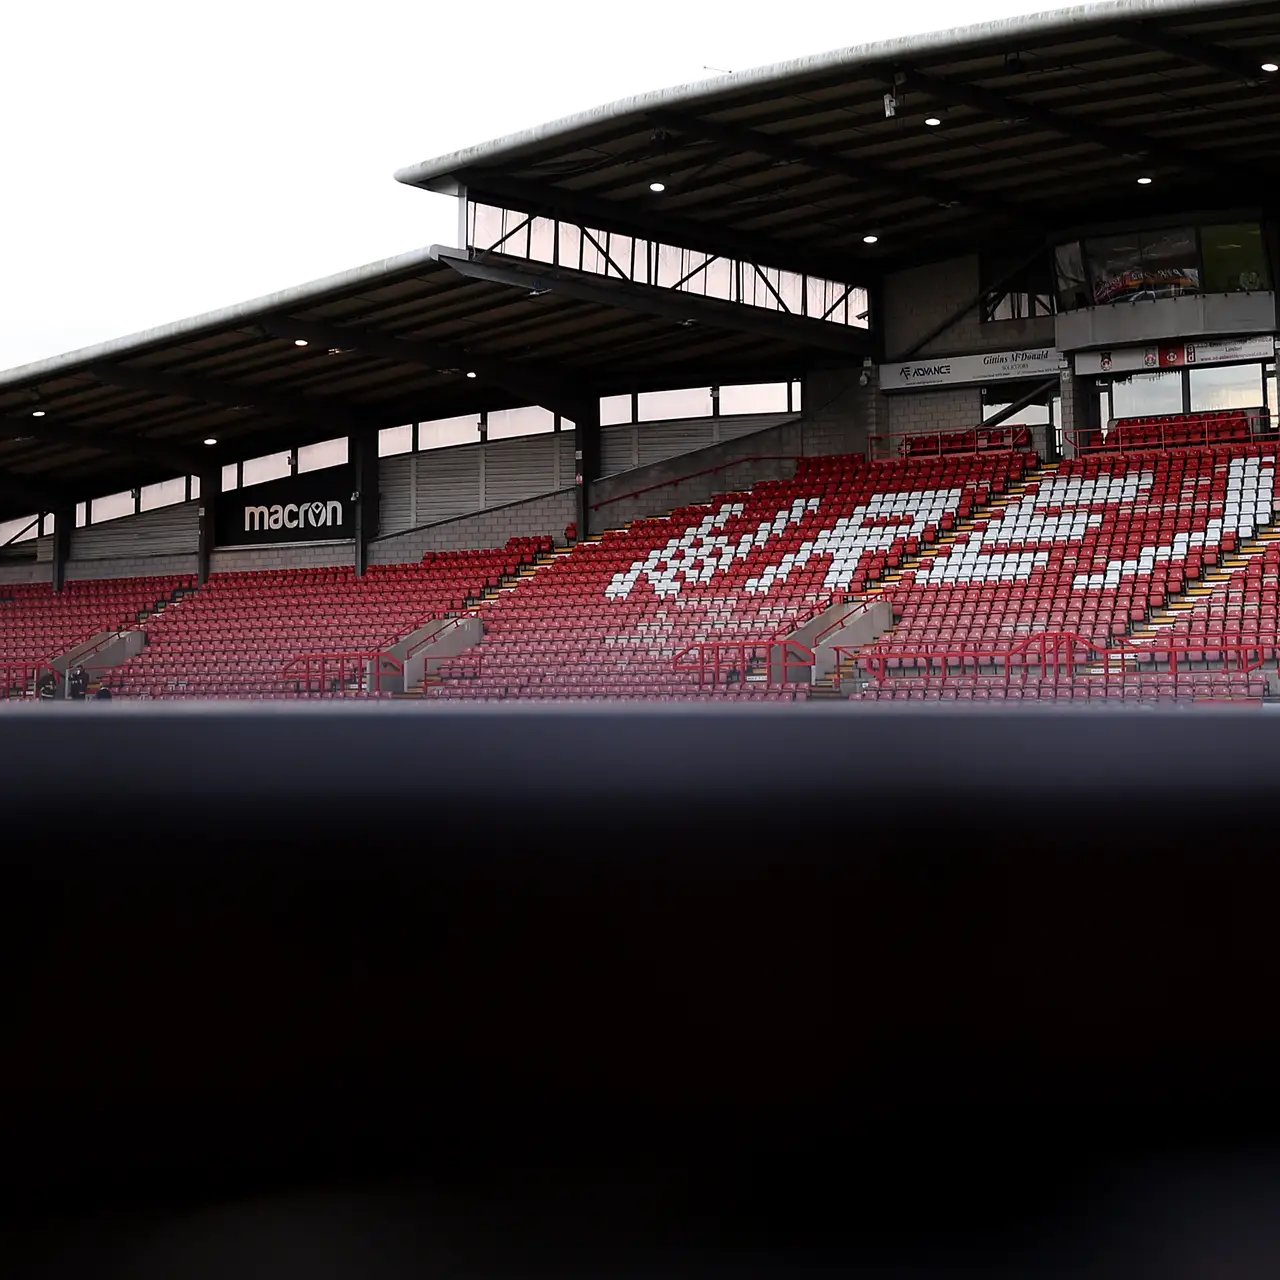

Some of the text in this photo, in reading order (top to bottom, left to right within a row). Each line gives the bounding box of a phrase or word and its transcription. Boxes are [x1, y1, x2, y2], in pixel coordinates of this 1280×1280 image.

[982, 355, 1008, 365] Gittins
[912, 365, 951, 378] ADVANCE
[244, 498, 342, 532] macron
